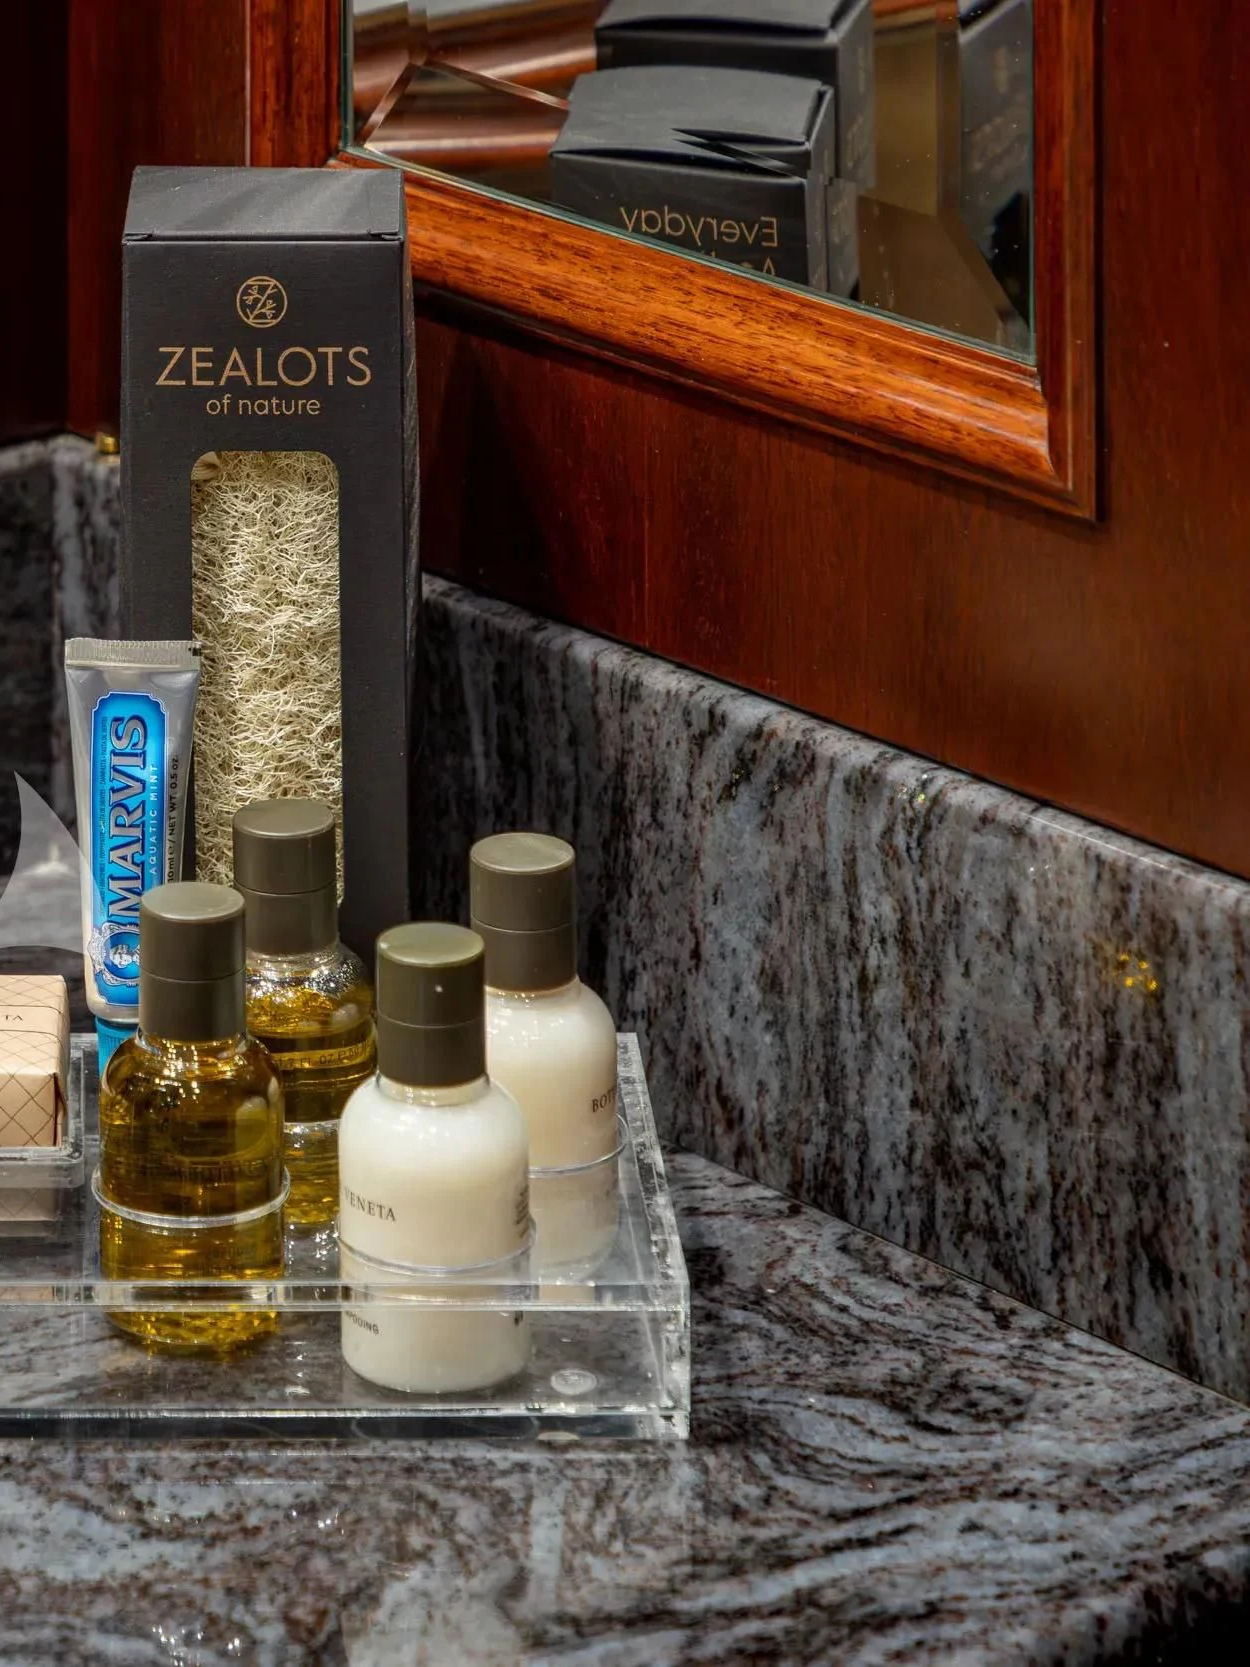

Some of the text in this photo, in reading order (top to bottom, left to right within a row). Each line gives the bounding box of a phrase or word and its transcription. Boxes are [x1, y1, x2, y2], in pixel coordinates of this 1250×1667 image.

[155, 346, 372, 387] ZEALOTS
[206, 394, 321, 415] of nature
[169, 773, 179, 790] 0.5
[107, 715, 148, 917] MARVIS
[149, 764, 158, 875] AQUATIC MINT
[168, 816, 177, 836] NET
[344, 1187, 397, 1222] VENETA
